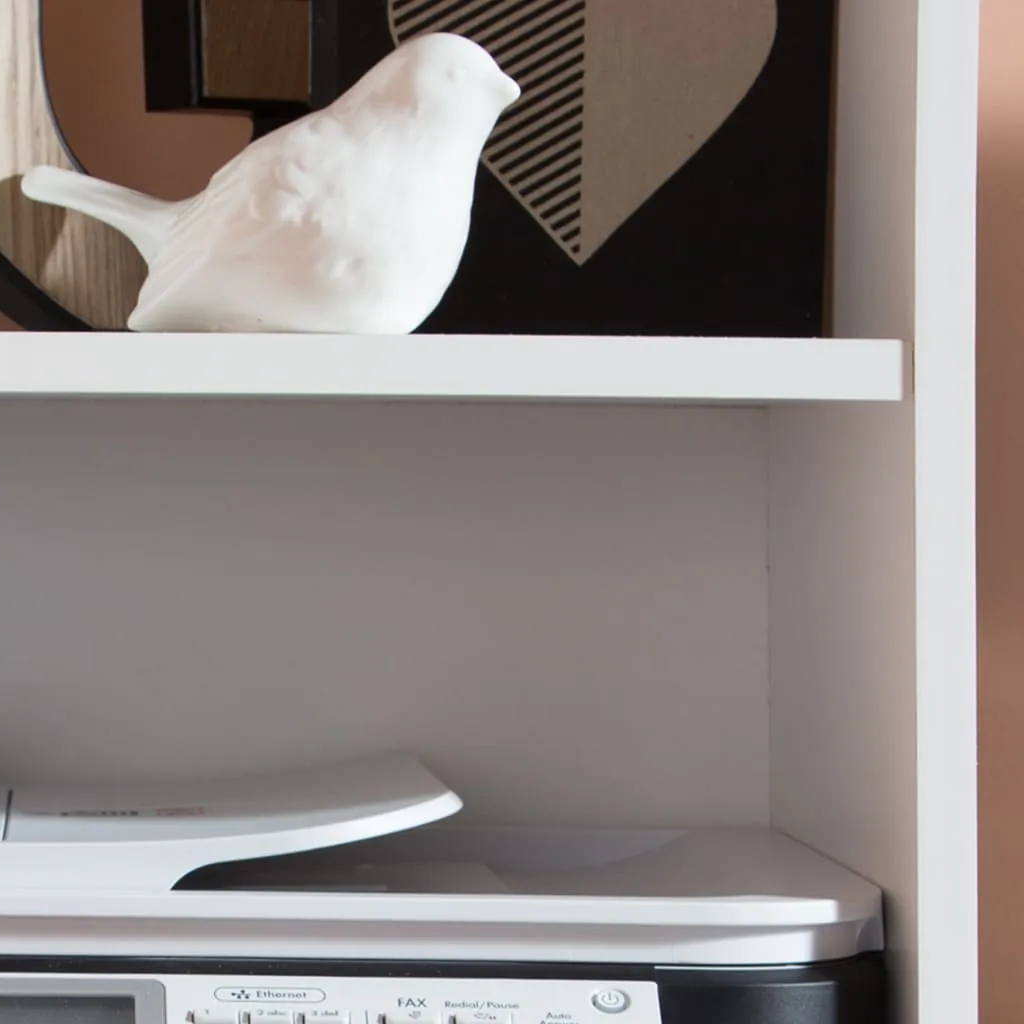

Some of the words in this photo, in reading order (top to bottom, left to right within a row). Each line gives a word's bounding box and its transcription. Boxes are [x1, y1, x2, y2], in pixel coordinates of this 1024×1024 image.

[256, 990, 307, 999] Ethernet
[397, 998, 427, 1008] FAX
[444, 1000, 520, 1010] Redial/Pause
[546, 1012, 572, 1021] Auto
